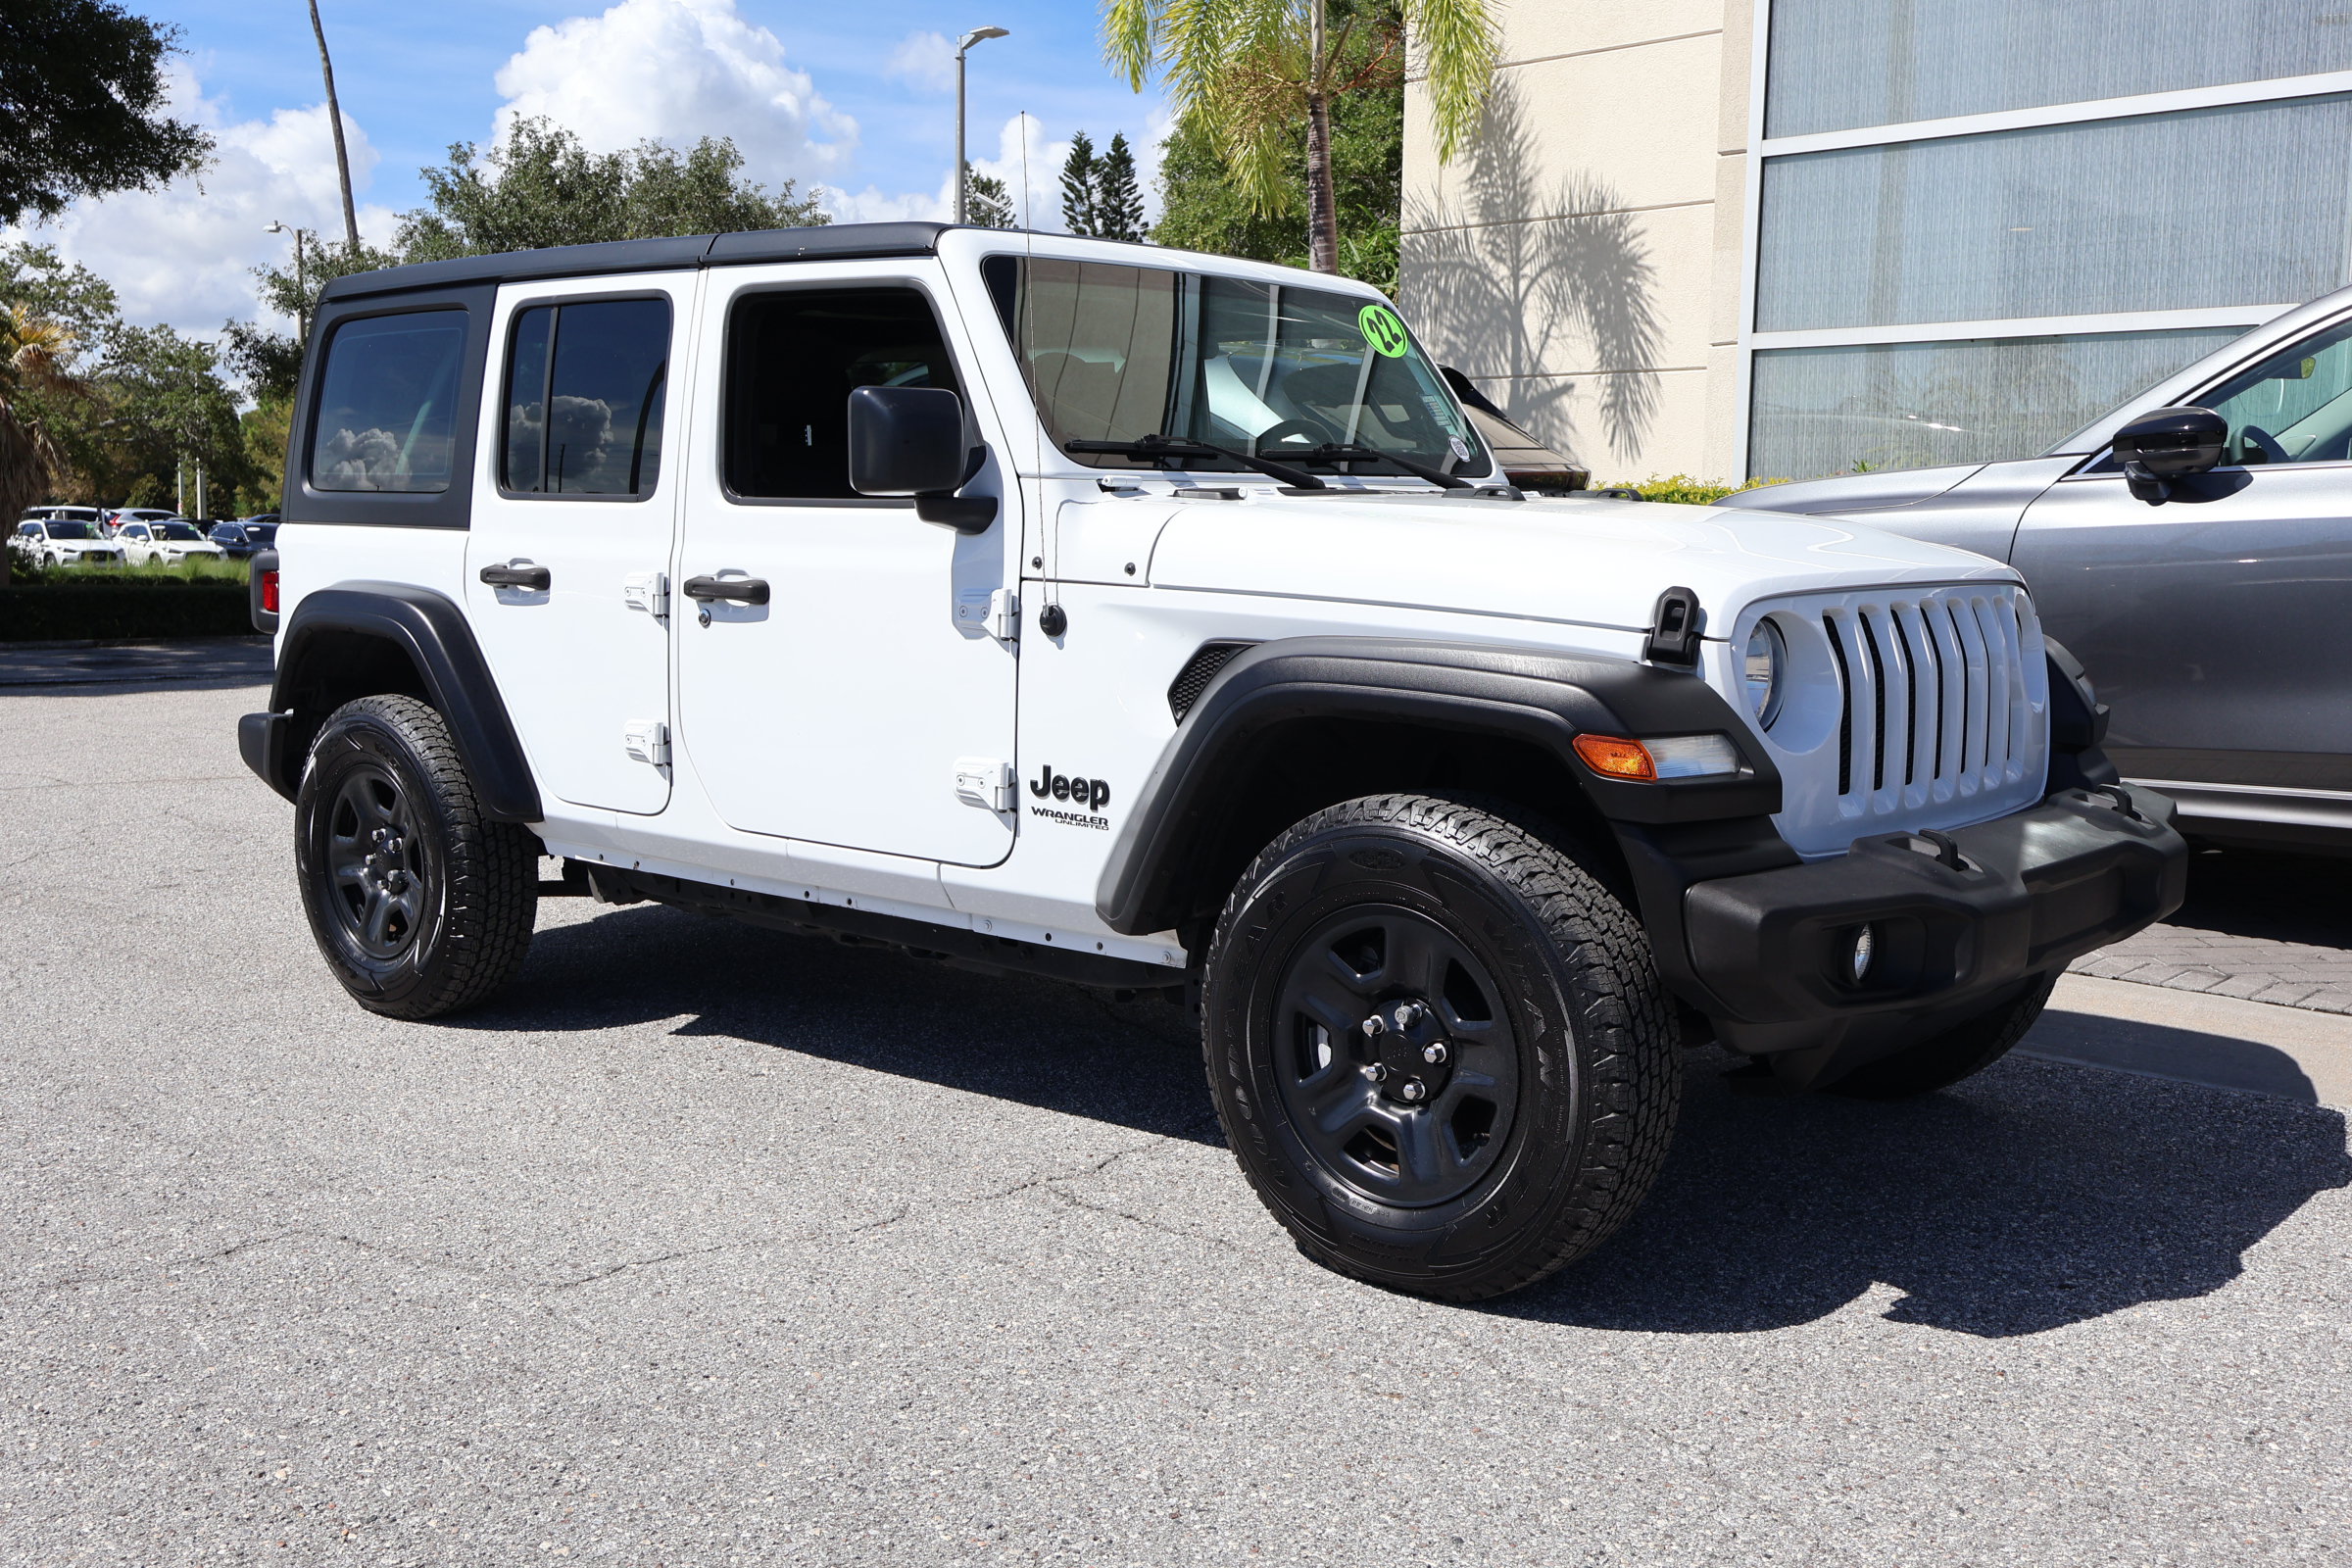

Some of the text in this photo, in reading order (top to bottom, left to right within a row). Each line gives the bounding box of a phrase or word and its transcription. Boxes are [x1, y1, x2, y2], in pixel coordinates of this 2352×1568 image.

[1366, 309, 1402, 353] 22
[1030, 763, 1110, 812] Jeep
[1031, 806, 1108, 827] WRANGLER
[1054, 818, 1109, 831] UNLIMITED
